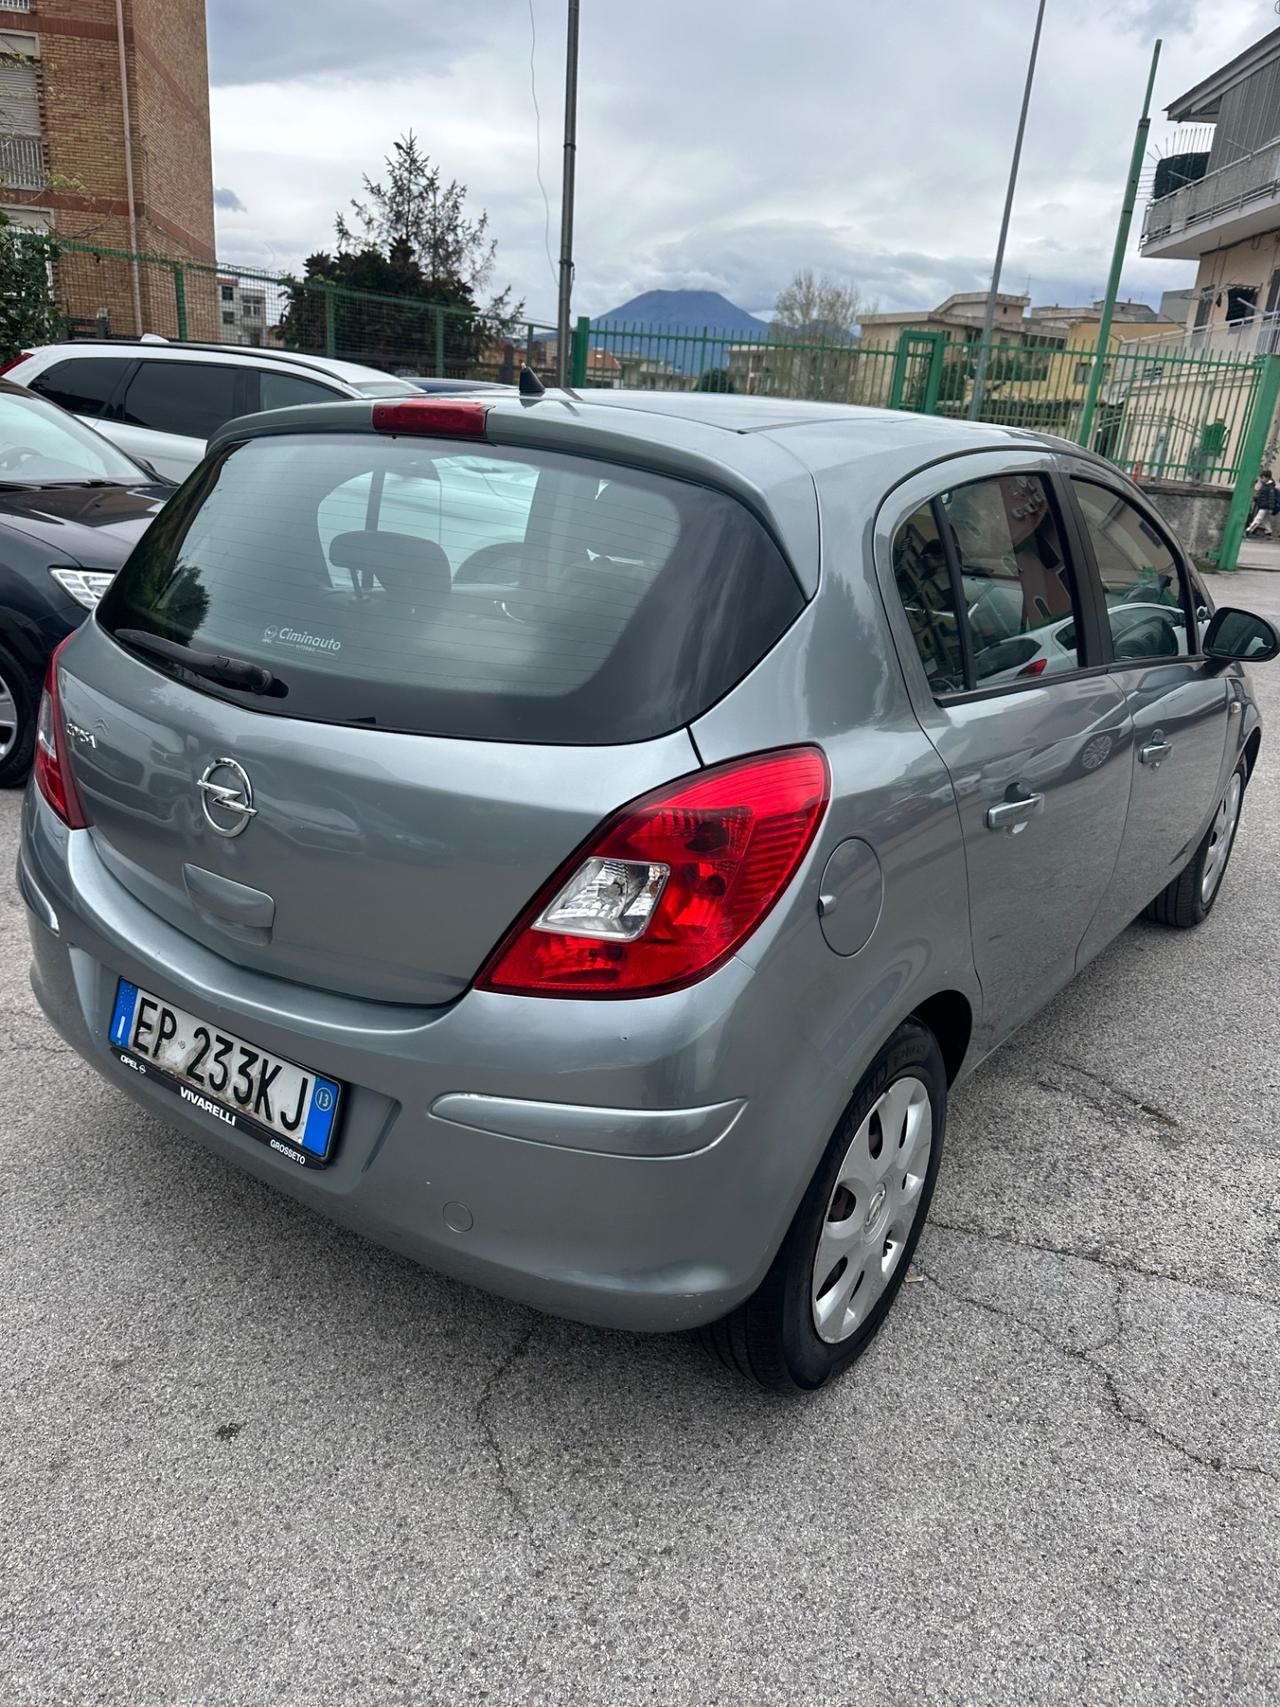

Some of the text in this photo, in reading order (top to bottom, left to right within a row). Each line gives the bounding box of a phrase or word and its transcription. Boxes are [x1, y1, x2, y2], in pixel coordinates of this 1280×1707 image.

[279, 627, 341, 650] Ciminauto
[120, 1053, 139, 1072] OPEL
[133, 997, 309, 1132] EP 233KJ
[179, 1086, 236, 1127] VIVARELLI
[317, 1092, 330, 1107] 13
[270, 1139, 306, 1165] GROSSETO
